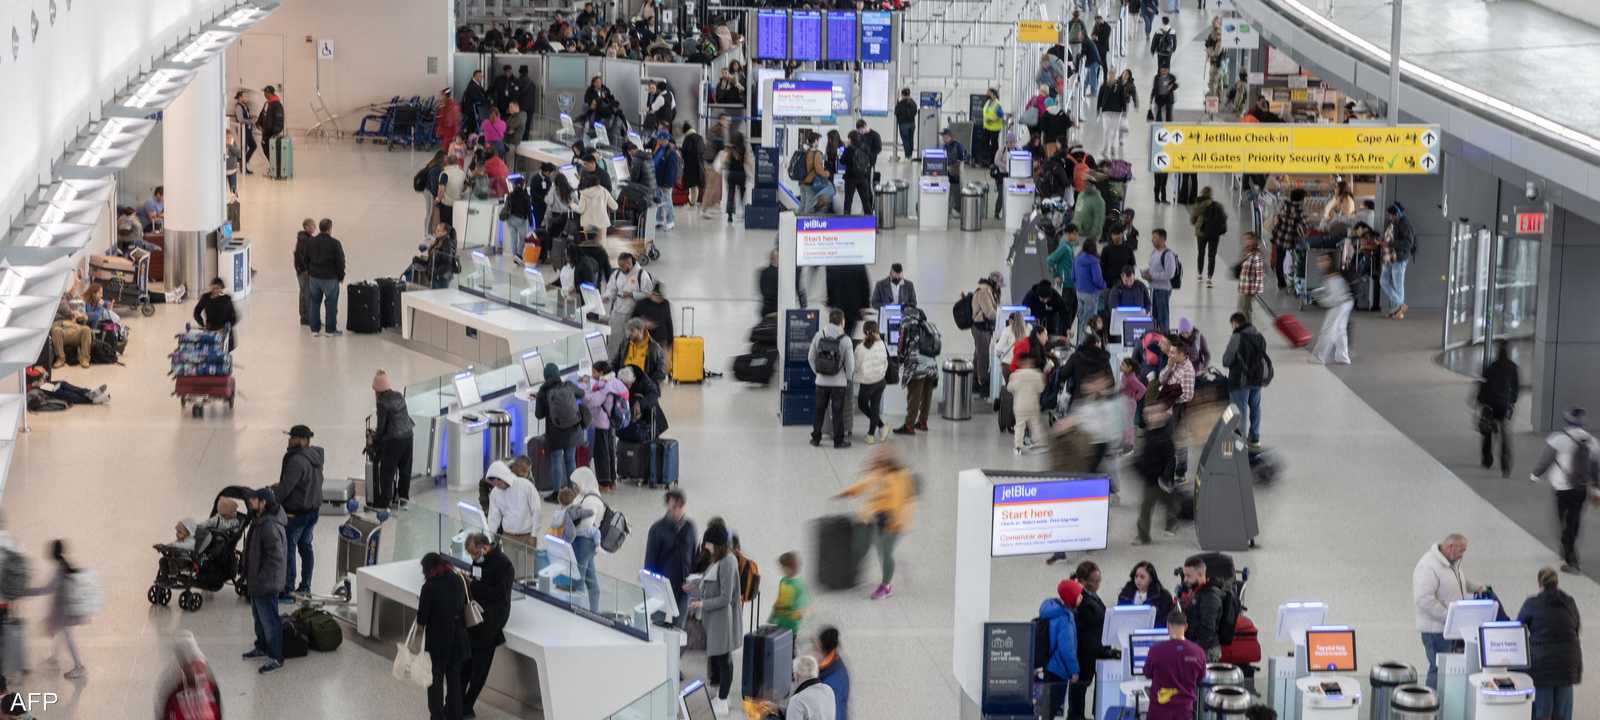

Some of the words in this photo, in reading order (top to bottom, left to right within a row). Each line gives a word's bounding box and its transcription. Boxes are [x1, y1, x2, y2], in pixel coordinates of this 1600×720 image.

[1204, 132, 1242, 143] JetBlue
[1245, 132, 1289, 143] Check-in
[1356, 133, 1382, 145] Cape
[1385, 132, 1399, 143] Air
[1192, 153, 1207, 162] All
[1211, 153, 1241, 162] Gates
[1248, 153, 1286, 164] Priority
[1289, 153, 1330, 164] Security
[1335, 153, 1342, 162] &
[1346, 153, 1365, 162] TSA
[1368, 153, 1385, 162] Pre
[803, 219, 827, 230] jetBlue
[1520, 213, 1542, 231] EXIT
[1001, 484, 1037, 500] jetBlue
[1001, 509, 1028, 521] Start
[1030, 508, 1054, 519] here
